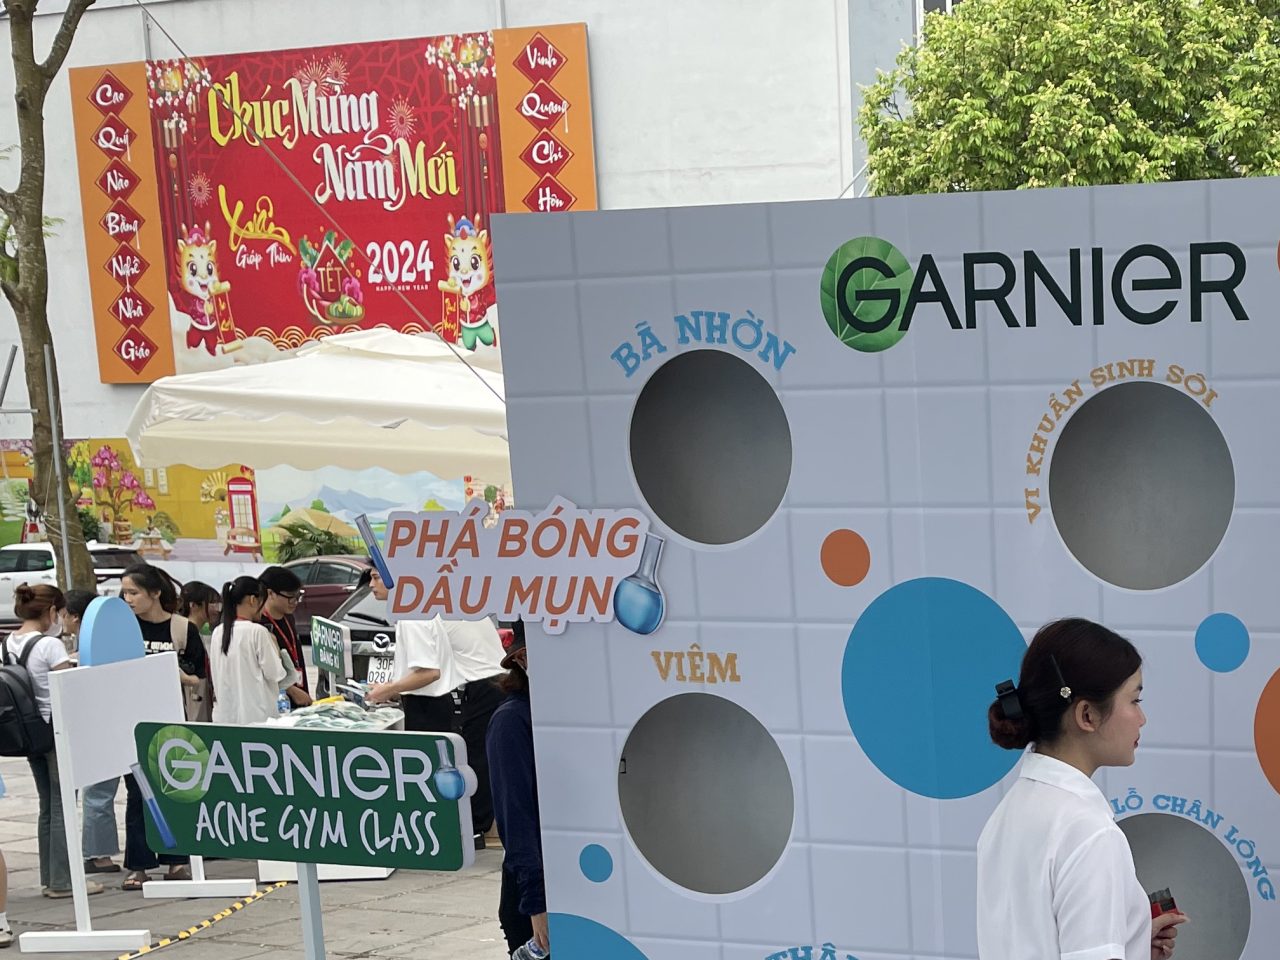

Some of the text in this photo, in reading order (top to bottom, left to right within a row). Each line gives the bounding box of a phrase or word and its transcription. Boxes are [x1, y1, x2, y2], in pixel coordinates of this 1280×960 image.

[526, 44, 558, 69] Vinh
[96, 84, 125, 106] Cao
[207, 71, 290, 147] Chúc
[521, 92, 569, 133] Quang
[98, 126, 131, 161] Quý
[532, 140, 563, 164] Chi
[106, 169, 129, 193] Nào
[312, 137, 460, 212] Năm Mới
[235, 242, 293, 270] Giáp Thìn
[317, 258, 343, 293] TẾT
[366, 240, 434, 284] 2024
[837, 241, 1249, 333] GARNIER
[118, 297, 143, 320] Nhà
[121, 339, 150, 361] Giáo
[610, 310, 797, 378] BÃ NHỜN
[1024, 359, 1218, 525] VI KHUẨN SINH SÔI
[387, 505, 641, 559] PHÁ BÓNG
[392, 558, 614, 628] DẦU MỤN
[650, 643, 741, 684] VIÊM
[158, 738, 437, 803] GARNIER
[195, 801, 441, 856] ACNE GYM CLASS
[1153, 794, 1224, 830] CHÂN
[1224, 825, 1276, 901] LÔNG
